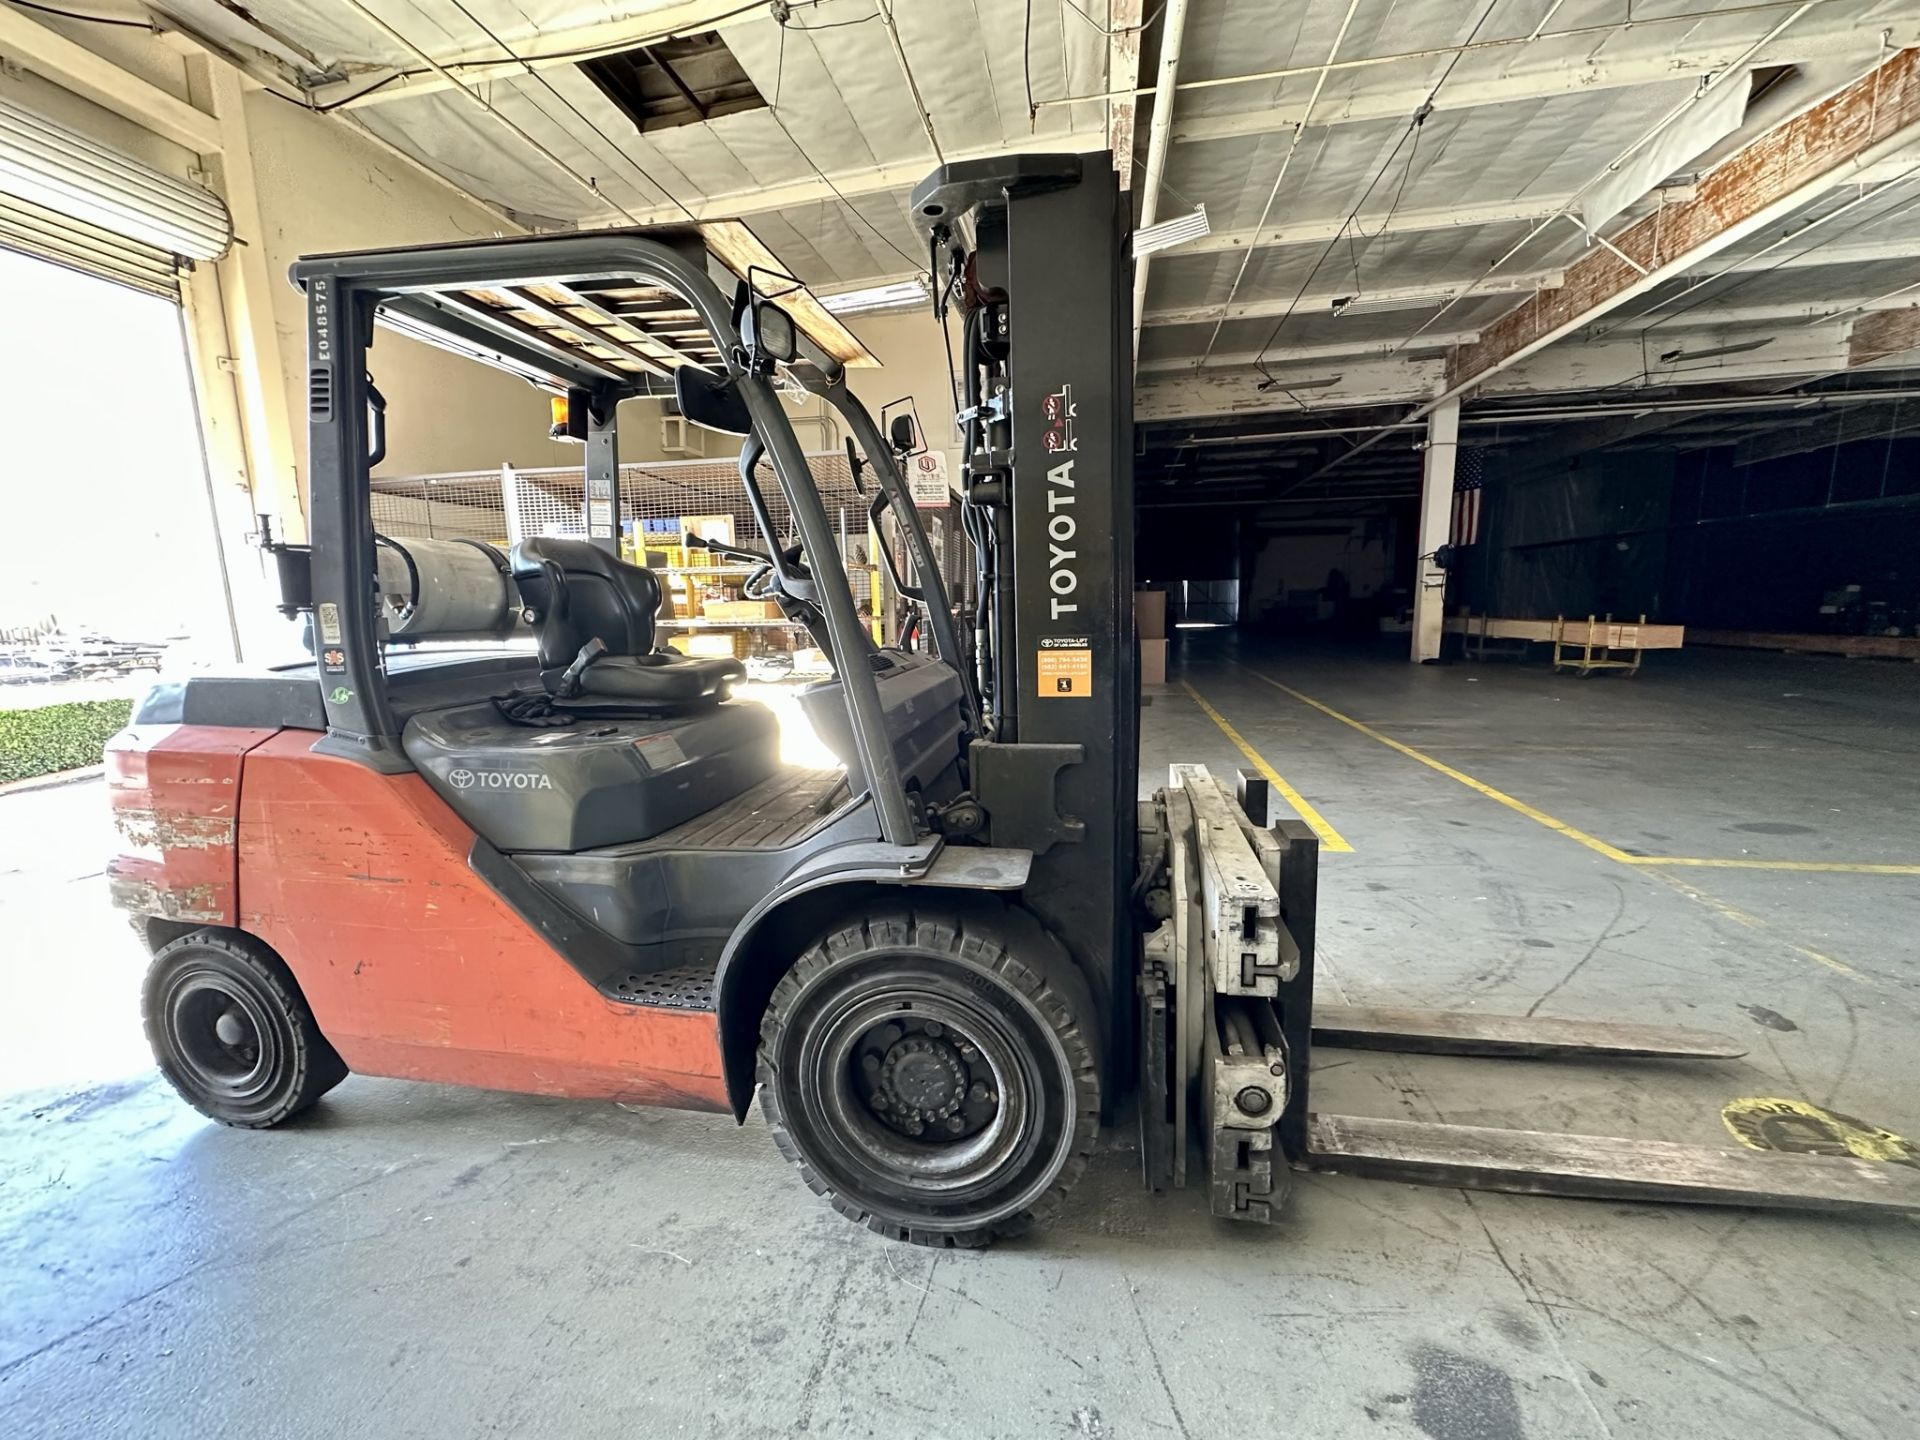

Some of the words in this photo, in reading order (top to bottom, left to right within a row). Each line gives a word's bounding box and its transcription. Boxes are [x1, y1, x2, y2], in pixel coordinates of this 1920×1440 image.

[314, 281, 331, 361] E048575
[1047, 459, 1078, 620] TOYOTA
[477, 771, 553, 790] TOYOTA
